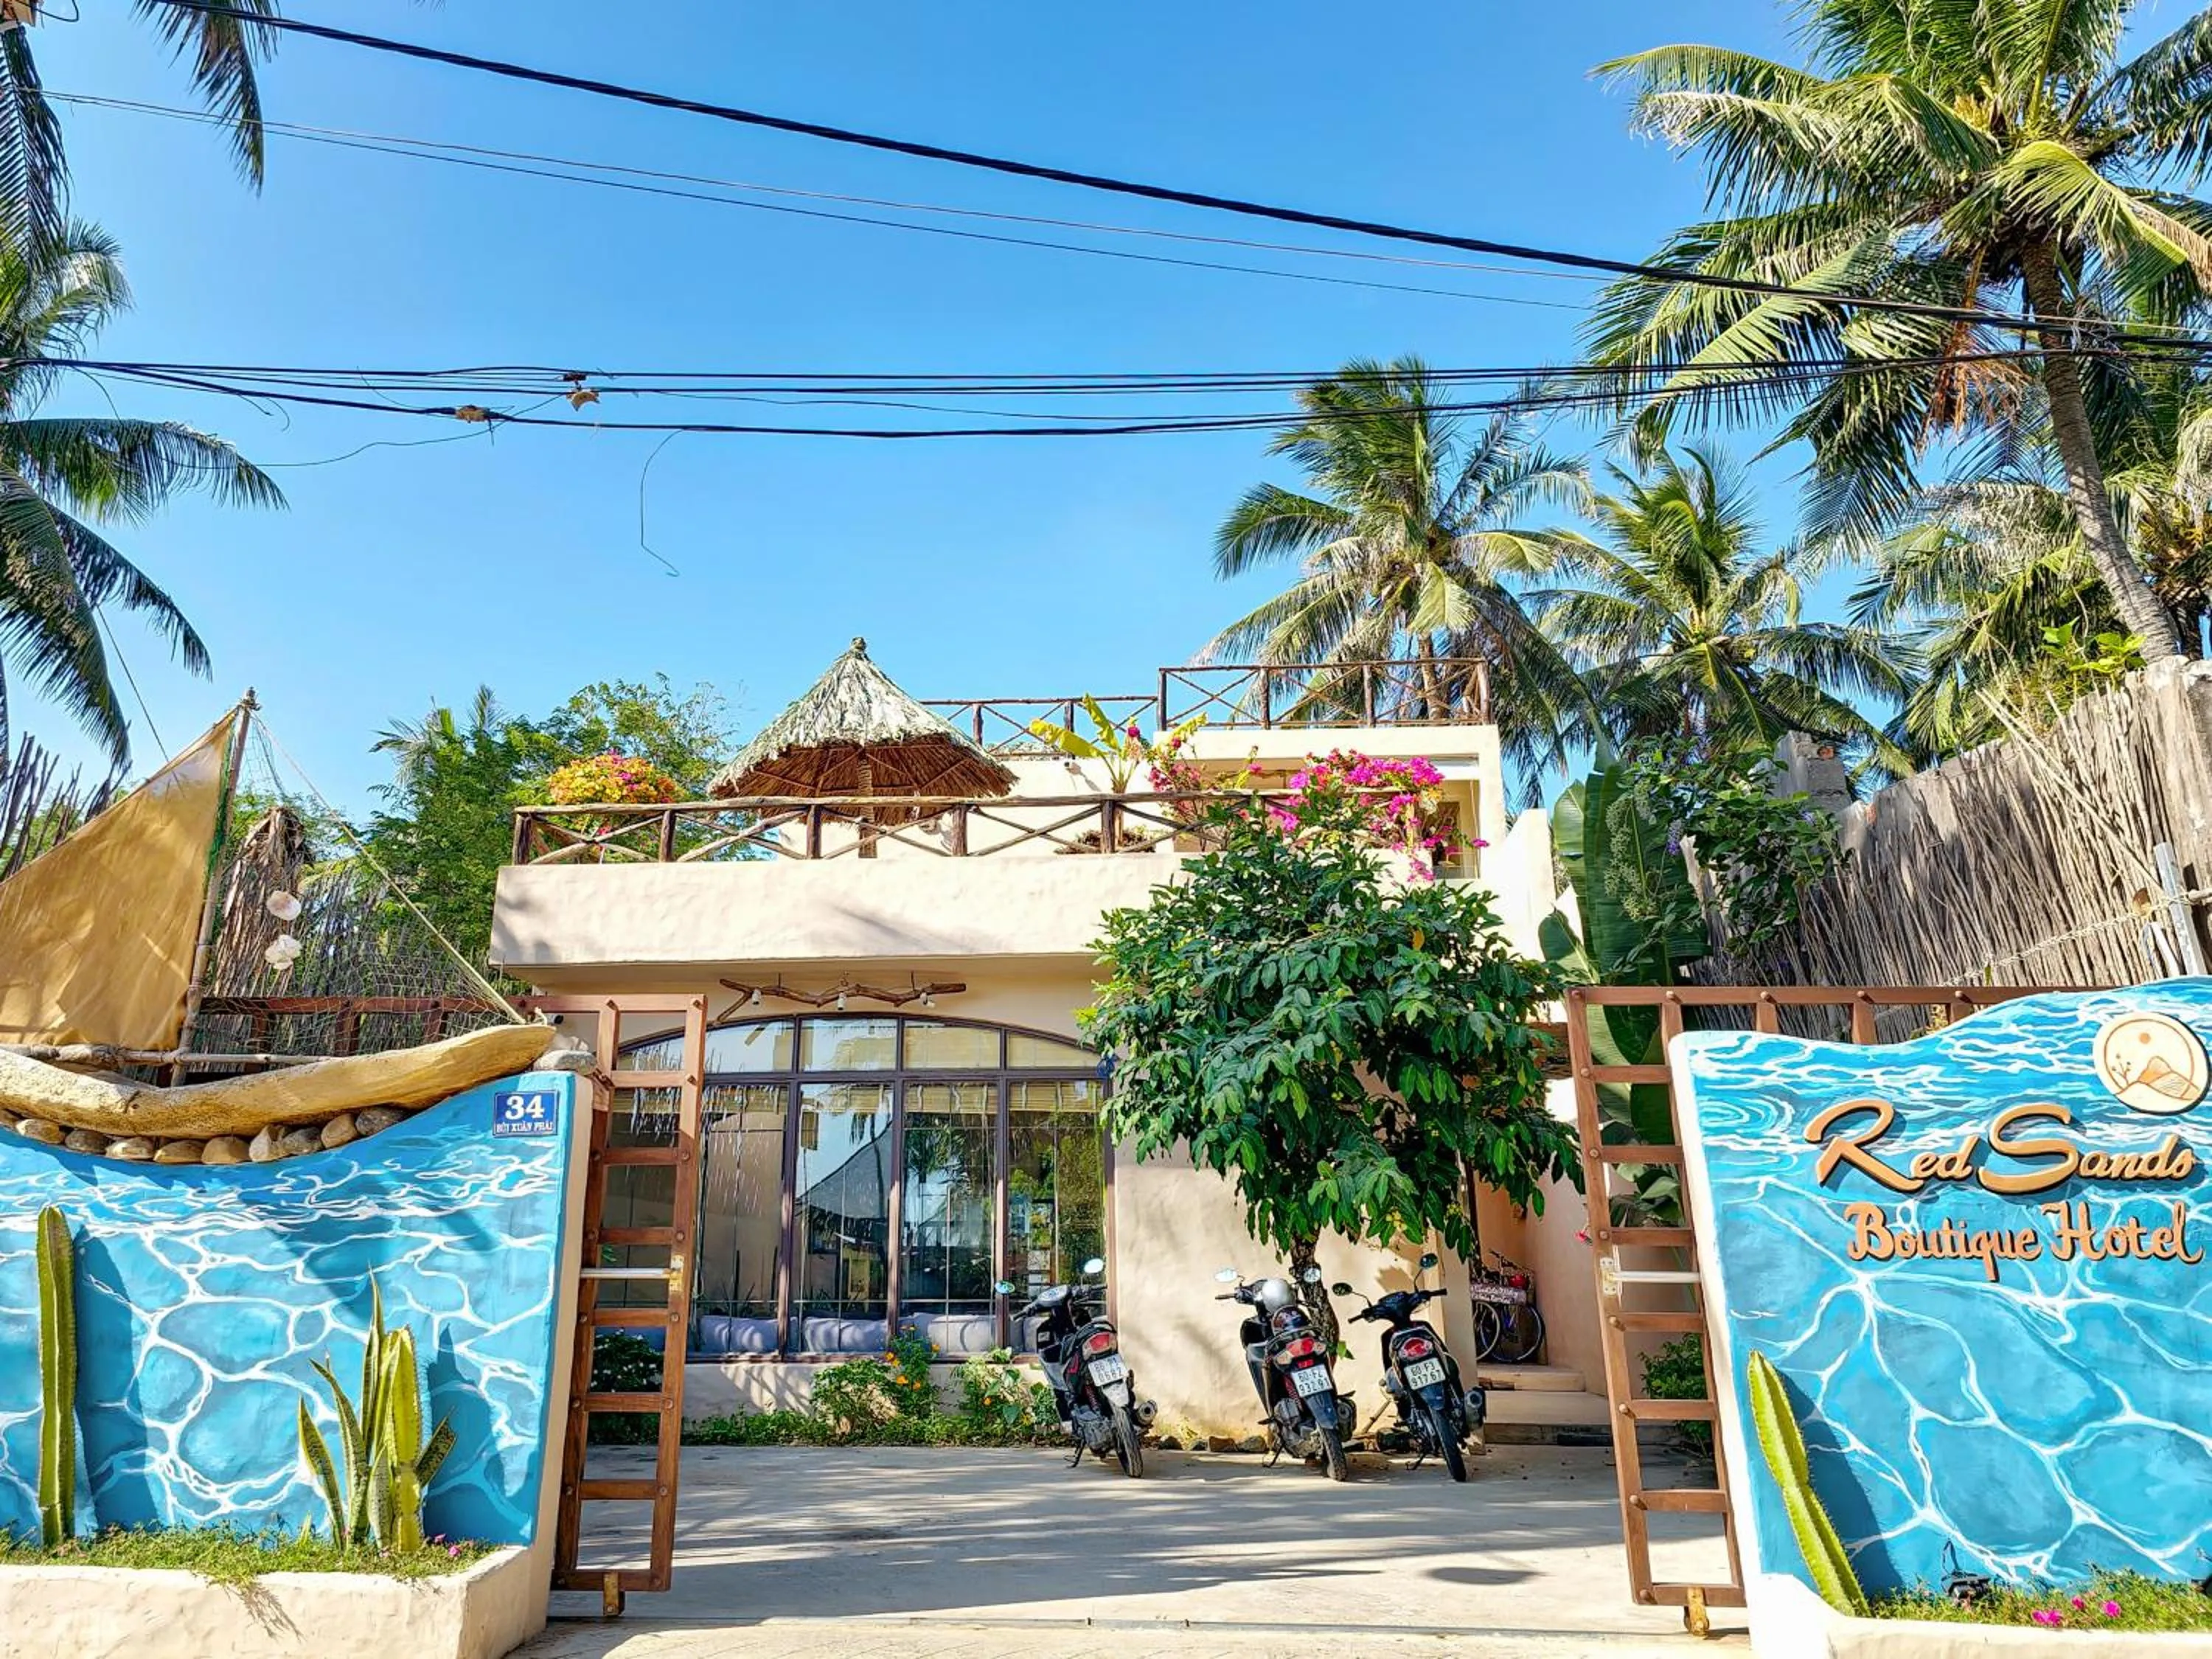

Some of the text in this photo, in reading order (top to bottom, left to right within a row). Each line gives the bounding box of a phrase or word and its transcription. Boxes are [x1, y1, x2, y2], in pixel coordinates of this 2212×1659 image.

[505, 1095, 545, 1120] 34
[1804, 1099, 2197, 1194] Red Sands
[1844, 1200, 2204, 1281] Boutique Hotel
